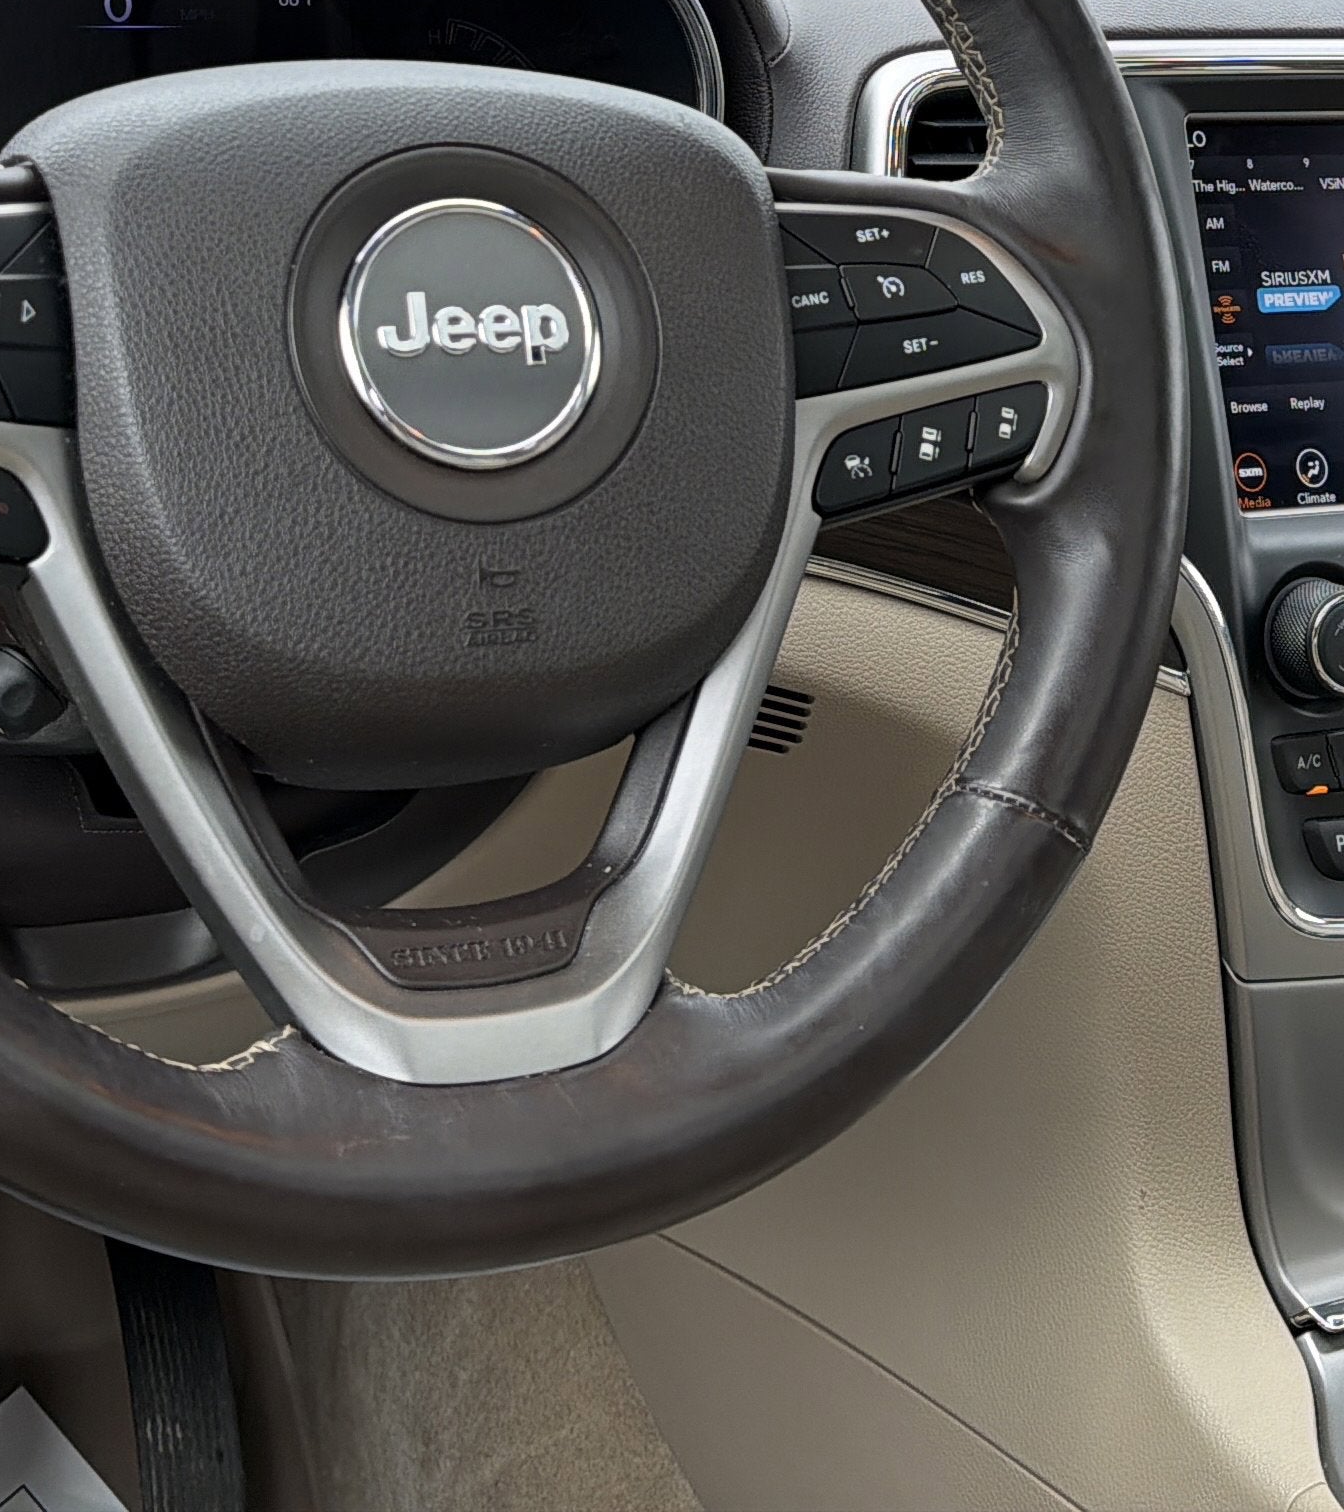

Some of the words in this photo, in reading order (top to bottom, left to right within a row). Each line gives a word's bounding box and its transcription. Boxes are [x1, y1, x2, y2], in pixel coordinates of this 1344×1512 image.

[1246, 158, 1254, 169] 8
[1302, 157, 1310, 168] 9
[1191, 179, 1215, 192] The
[1206, 218, 1225, 230] AM
[856, 227, 890, 243] SET+
[1211, 260, 1231, 273] FM
[960, 270, 986, 285] RES
[1260, 269, 1331, 286] SIRIUSXM
[791, 291, 830, 308] CANC
[1263, 291, 1334, 307] PREVIEW
[376, 290, 570, 366] Jeep
[1214, 343, 1244, 354] Source
[1217, 356, 1245, 367] Select
[1230, 400, 1269, 414] Browse
[1290, 396, 1325, 411] Replay
[1238, 466, 1264, 478] sxm
[1238, 495, 1272, 509] Media
[1297, 491, 1337, 505] Climate
[461, 608, 536, 628] SRS
[1296, 753, 1323, 772] A/C
[391, 939, 492, 968] SINCE
